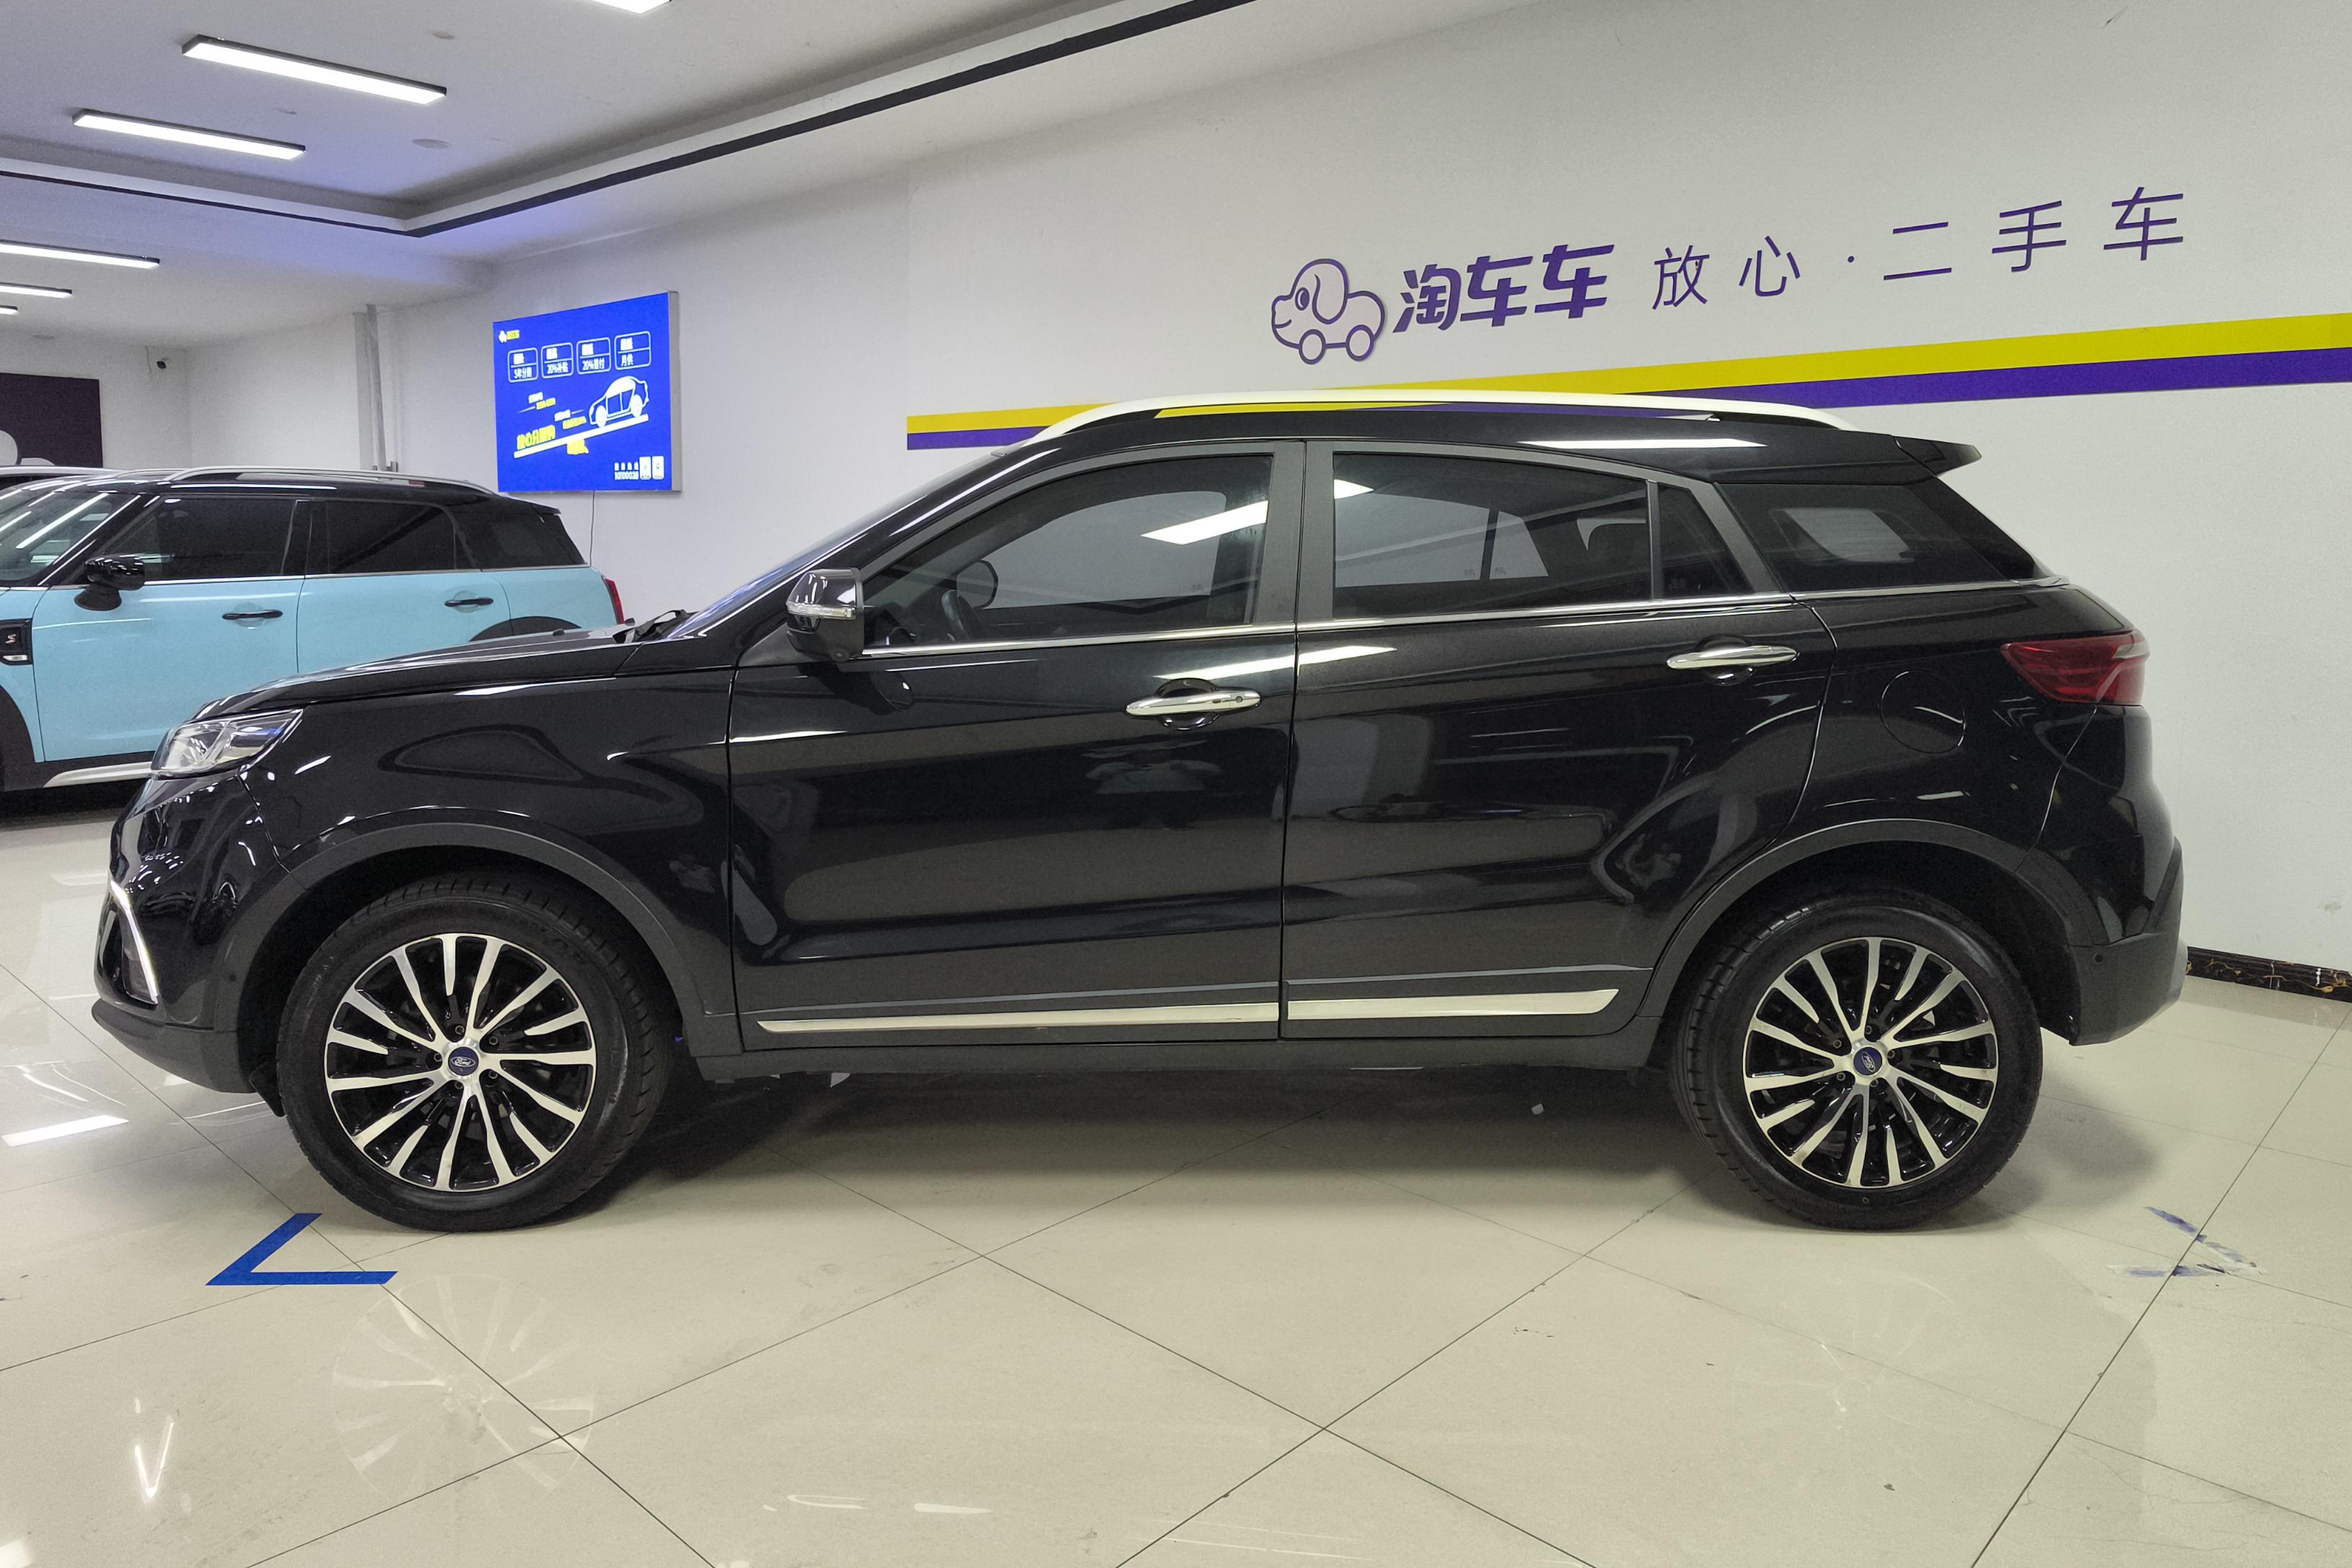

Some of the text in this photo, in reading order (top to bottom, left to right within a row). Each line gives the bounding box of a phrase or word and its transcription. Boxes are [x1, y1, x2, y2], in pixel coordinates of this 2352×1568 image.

[1392, 244, 1615, 333] 淘车车
[453, 1056, 473, 1066] Ford
[1863, 1054, 1874, 1069] Ford
